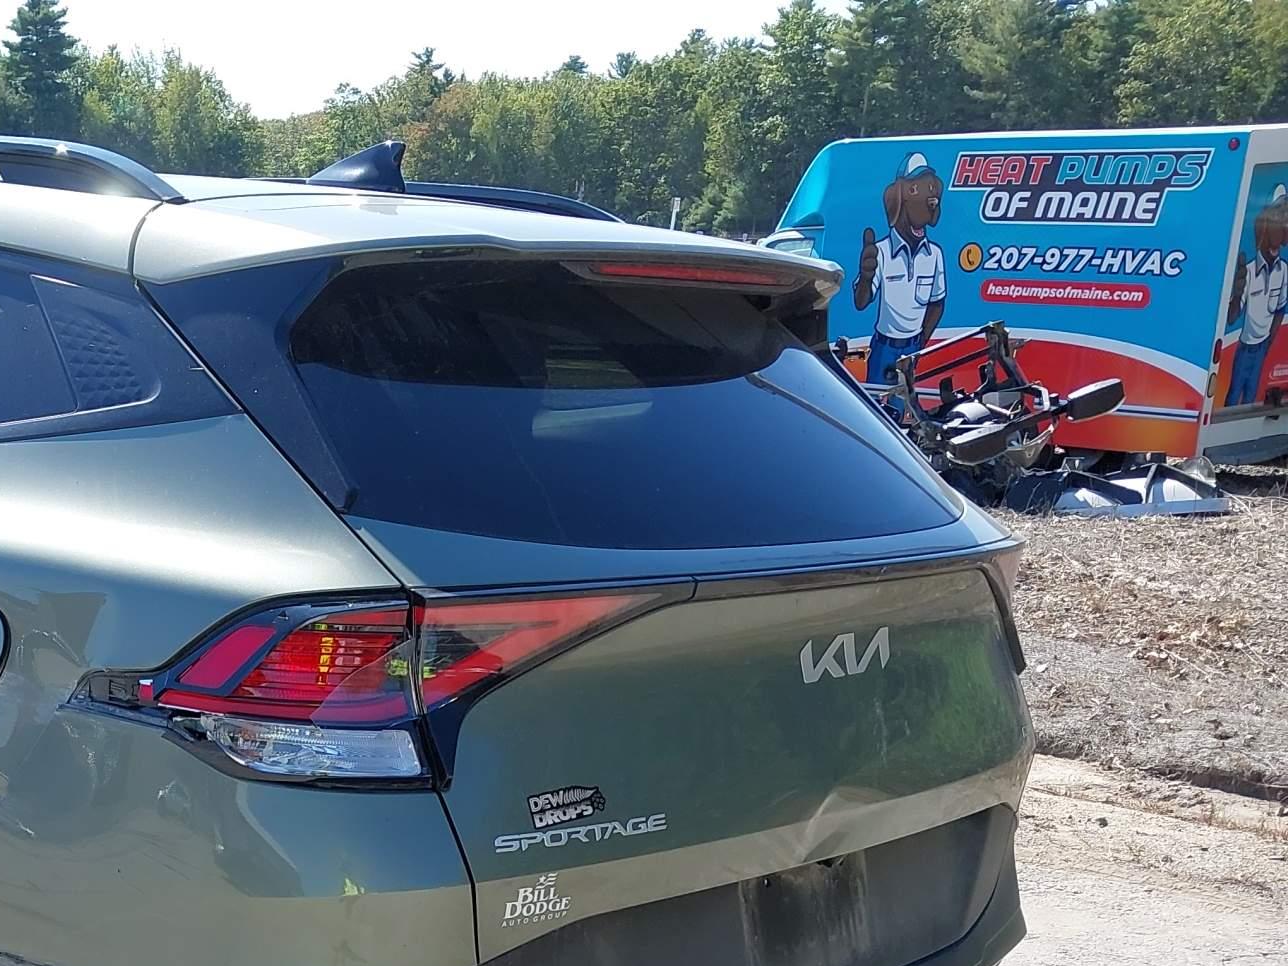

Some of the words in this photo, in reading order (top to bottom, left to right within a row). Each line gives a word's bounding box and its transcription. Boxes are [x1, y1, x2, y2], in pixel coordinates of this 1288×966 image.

[954, 156, 1053, 185] HEAT
[1055, 153, 1208, 185] PUMPS
[983, 191, 1032, 218] OF
[1034, 191, 1161, 220] MAINE
[983, 246, 1185, 276] 207-977-HVAC
[986, 283, 1144, 302] heatpumpsofmaine.com
[529, 790, 564, 813] DEW
[534, 802, 594, 829] DROPS
[494, 813, 668, 853] SPORTAGE
[501, 917, 529, 928] AUTO
[532, 910, 568, 923] GROUP
[503, 896, 572, 920] DODGE
